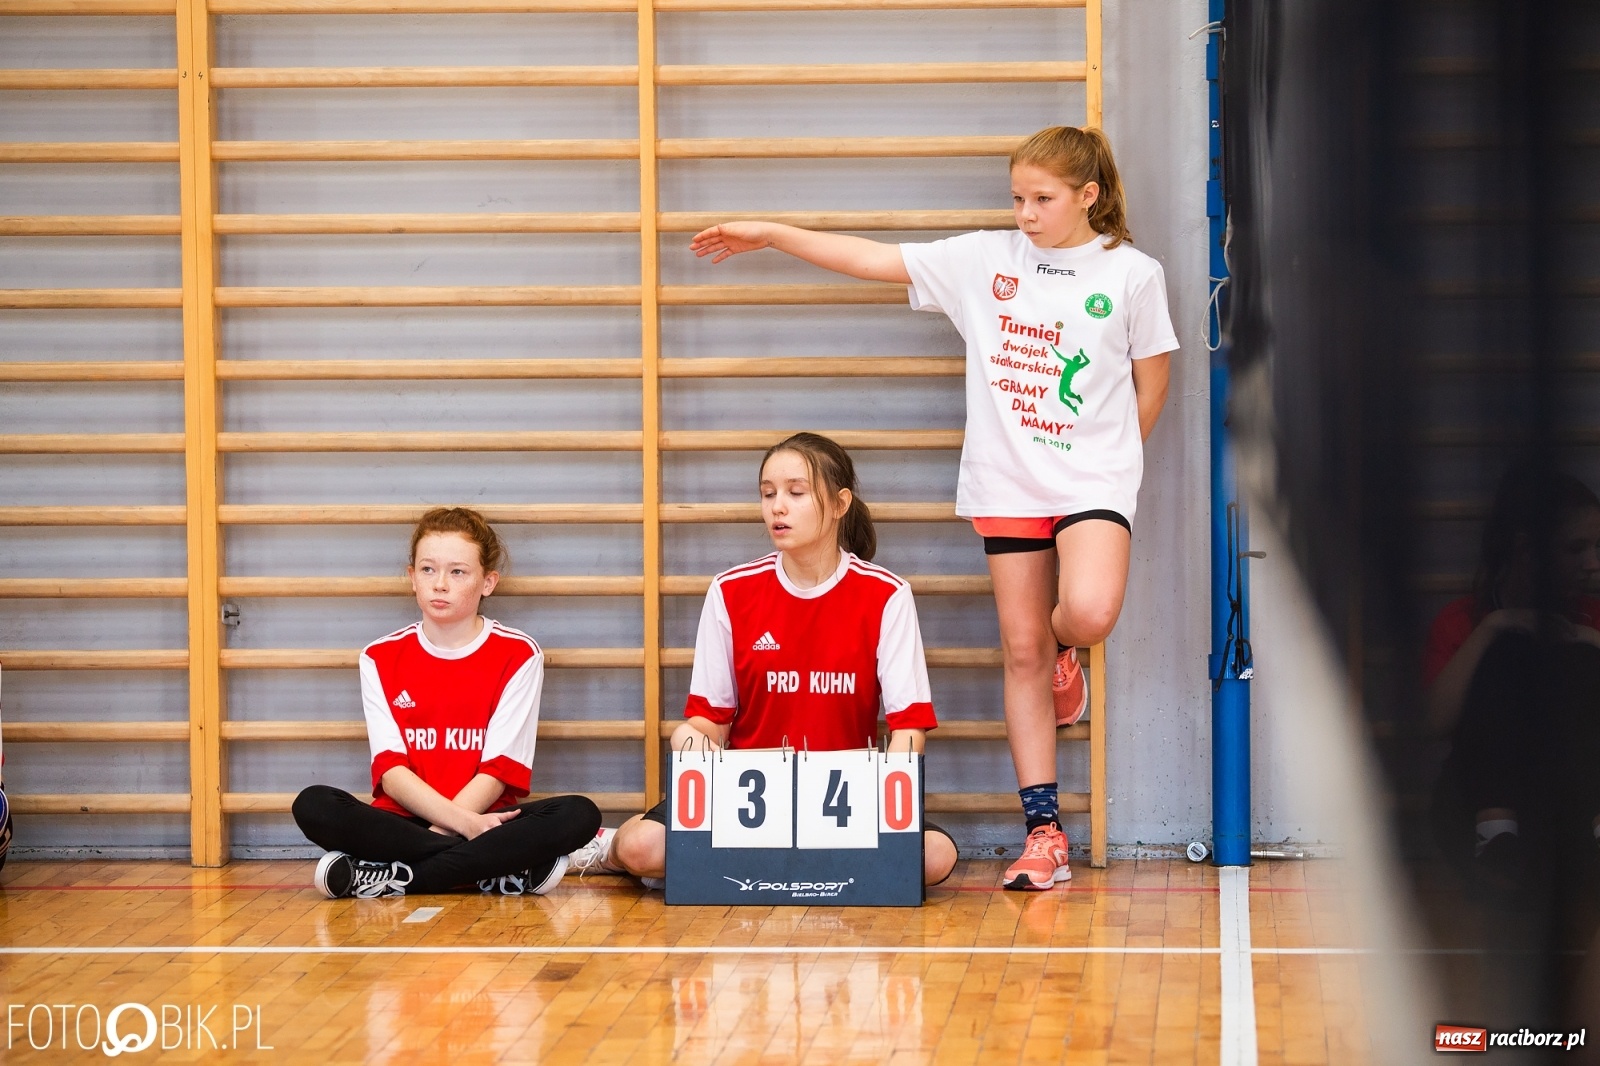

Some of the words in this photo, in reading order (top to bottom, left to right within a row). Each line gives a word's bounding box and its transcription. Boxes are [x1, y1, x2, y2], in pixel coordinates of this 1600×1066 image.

[998, 314, 1062, 346] Turniej
[1002, 339, 1049, 359] dwójek
[1011, 398, 1037, 415] DLA
[752, 643, 781, 651] adidas
[766, 670, 800, 693] PRD
[809, 671, 856, 695] KUHN
[404, 727, 437, 751] PRD
[445, 727, 487, 751] KUH
[677, 769, 706, 829] 0
[738, 769, 766, 829] 3
[822, 769, 852, 828] 4
[884, 770, 913, 831] 0
[758, 882, 849, 892] POLSPORT
